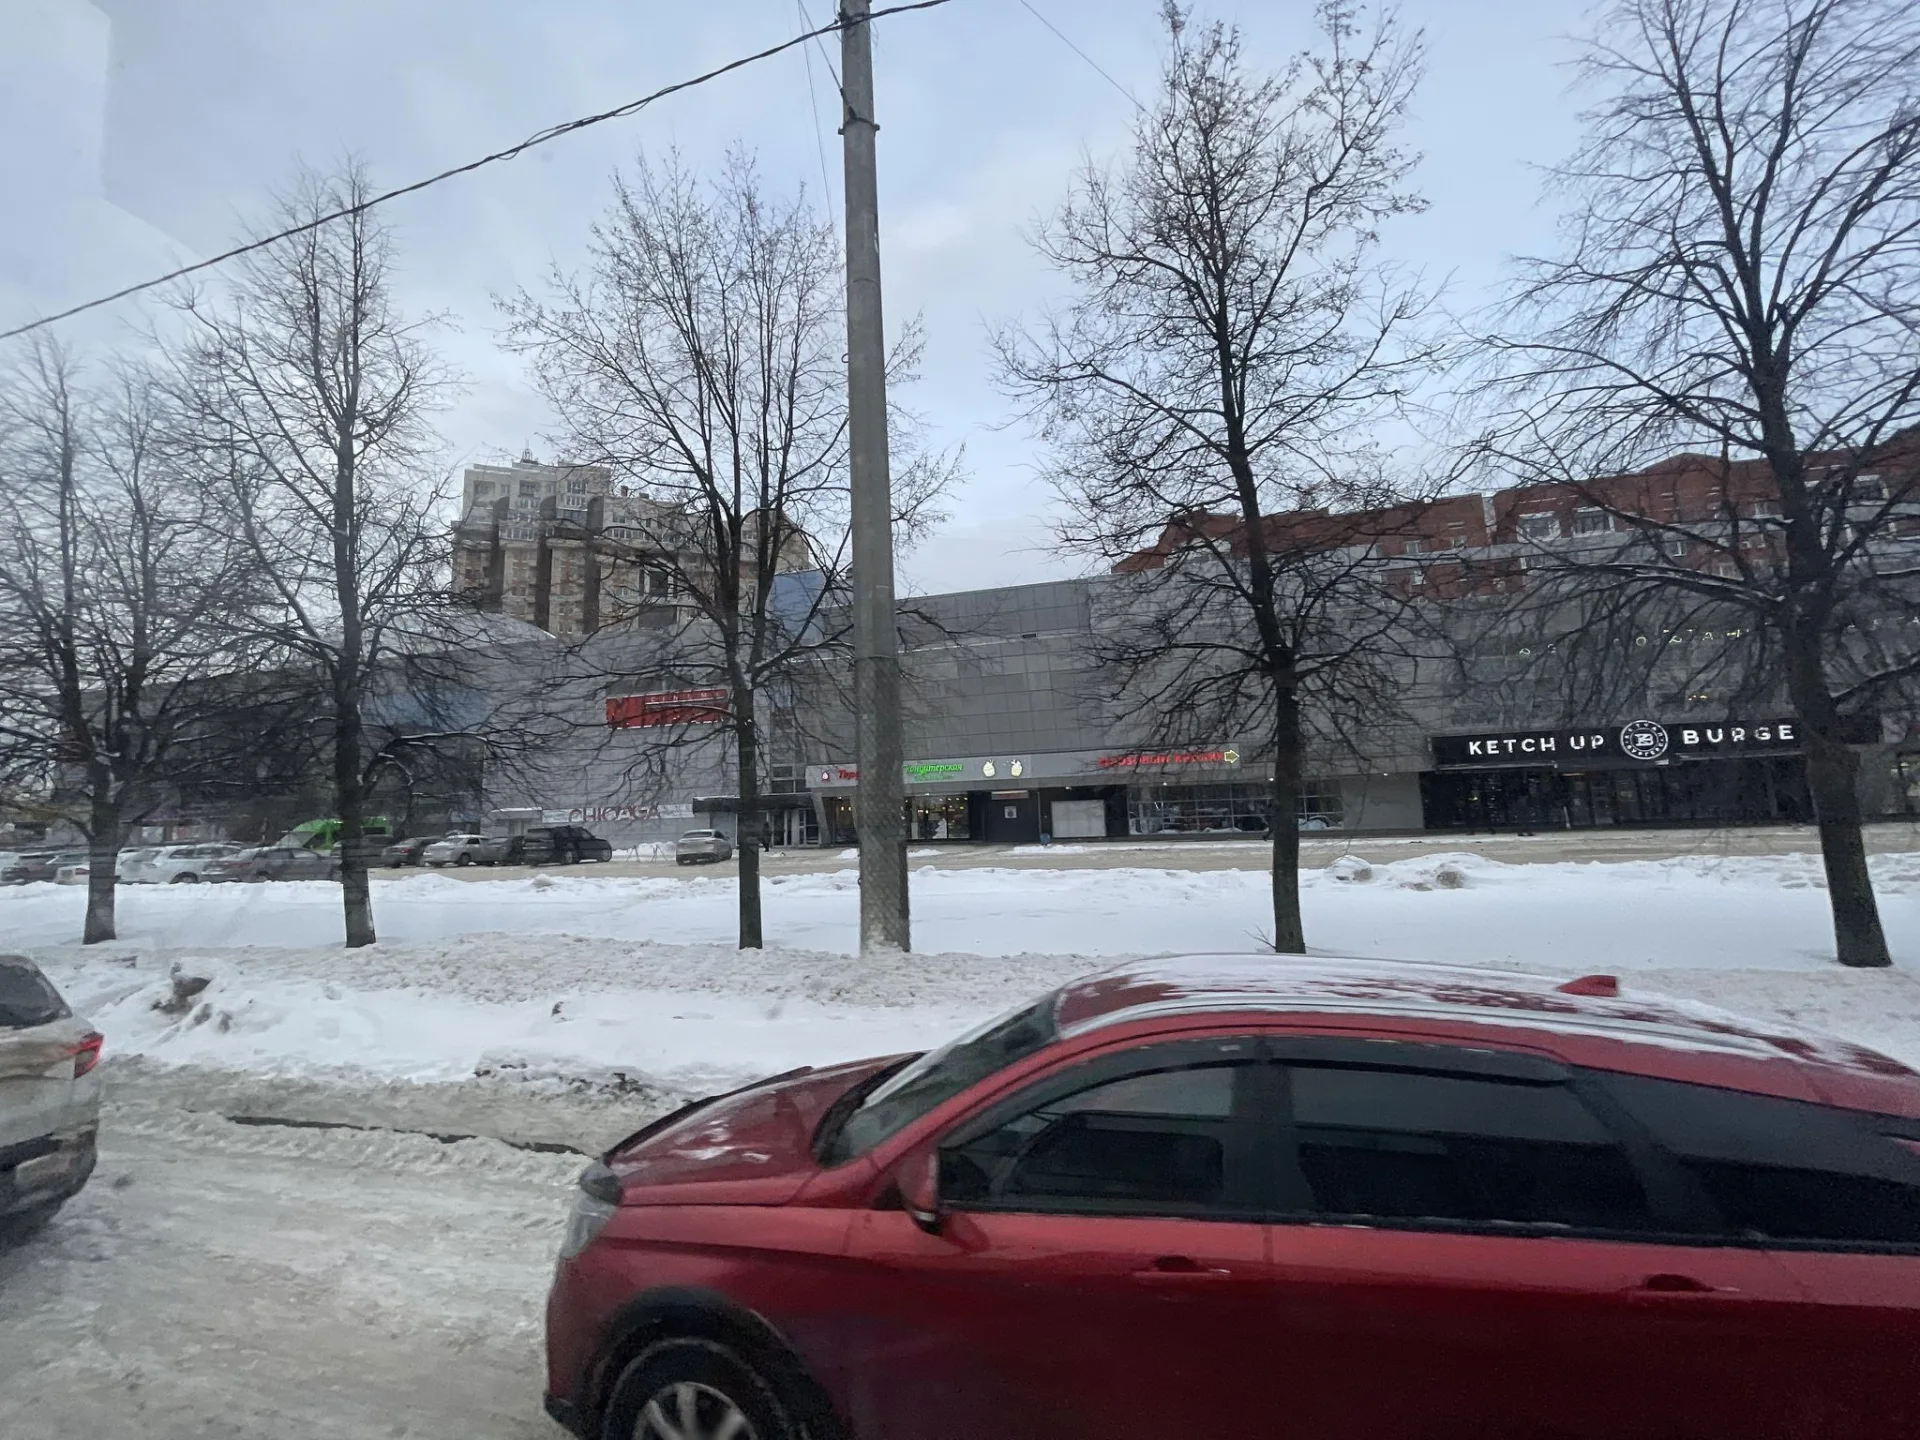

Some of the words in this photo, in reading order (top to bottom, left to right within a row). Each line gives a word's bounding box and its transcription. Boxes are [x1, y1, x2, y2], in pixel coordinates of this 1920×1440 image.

[1468, 737, 1556, 756] KETCH
[1569, 734, 1604, 750] UP
[1682, 724, 1795, 744] BURGE
